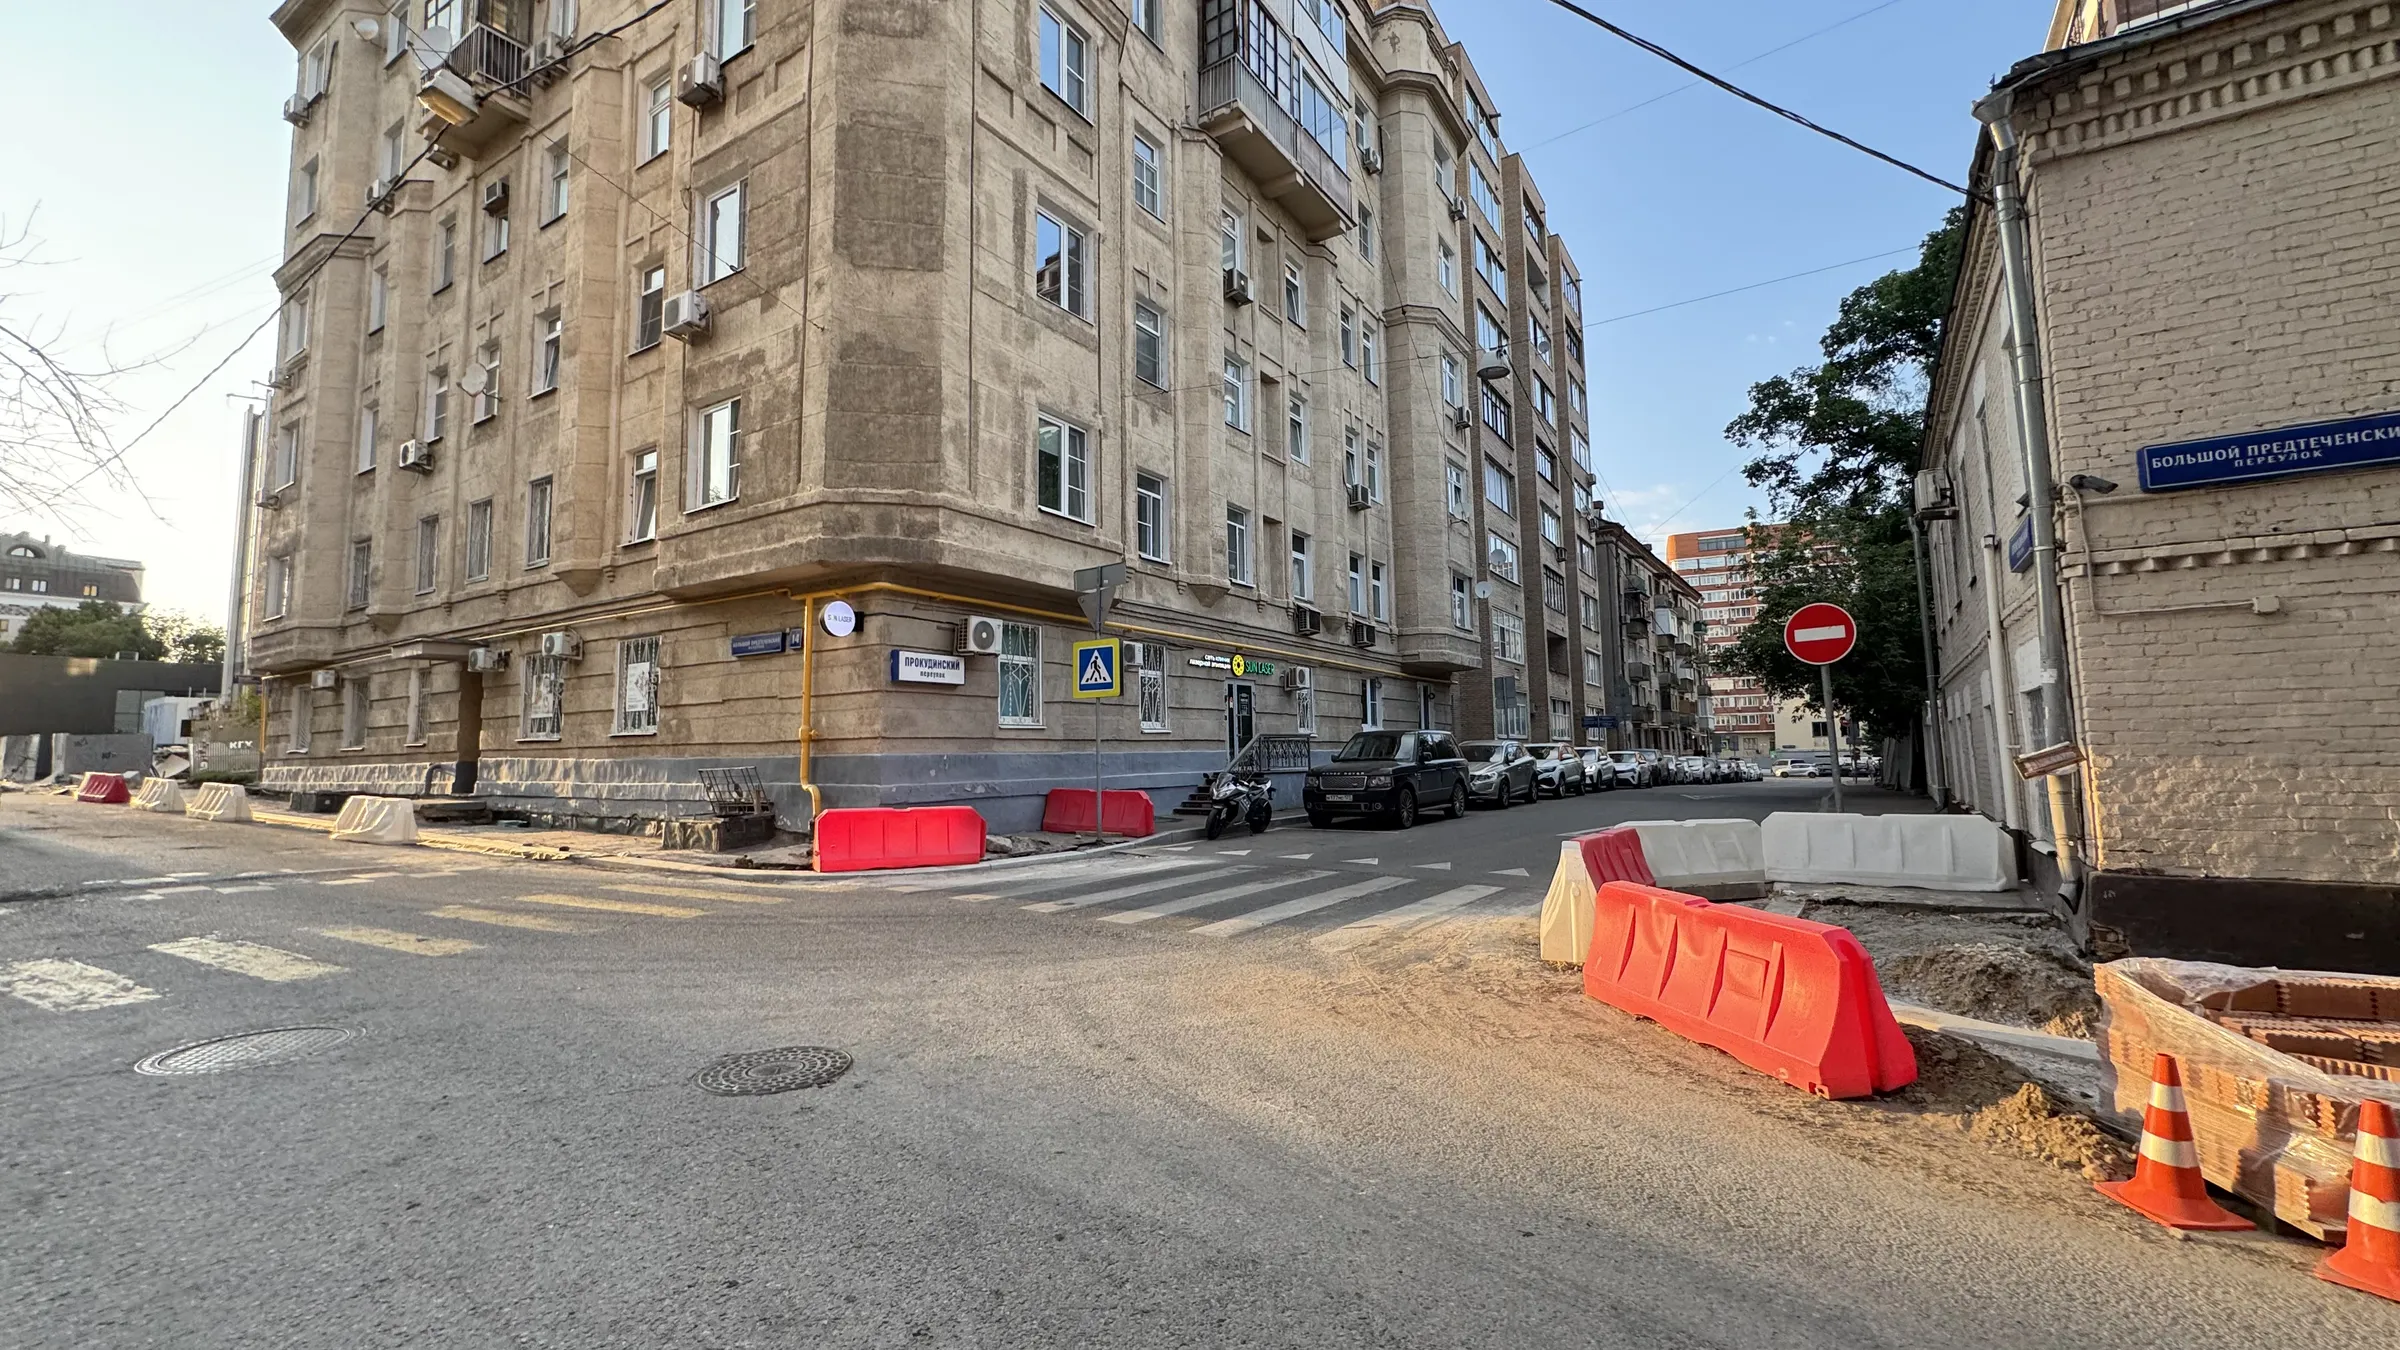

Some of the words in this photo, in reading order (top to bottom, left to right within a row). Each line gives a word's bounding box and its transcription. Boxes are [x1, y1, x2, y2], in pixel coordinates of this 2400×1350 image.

[2152, 445, 2240, 469] БОЛЬШОЙ
[2234, 449, 2323, 468] ПЕРЕУЛОК
[792, 633, 800, 644] 14
[904, 656, 960, 671] ПРОКУДИНСКИЙ
[1245, 660, 1257, 673] SUN
[1258, 662, 1275, 675] LASER
[920, 670, 945, 679] переулок
